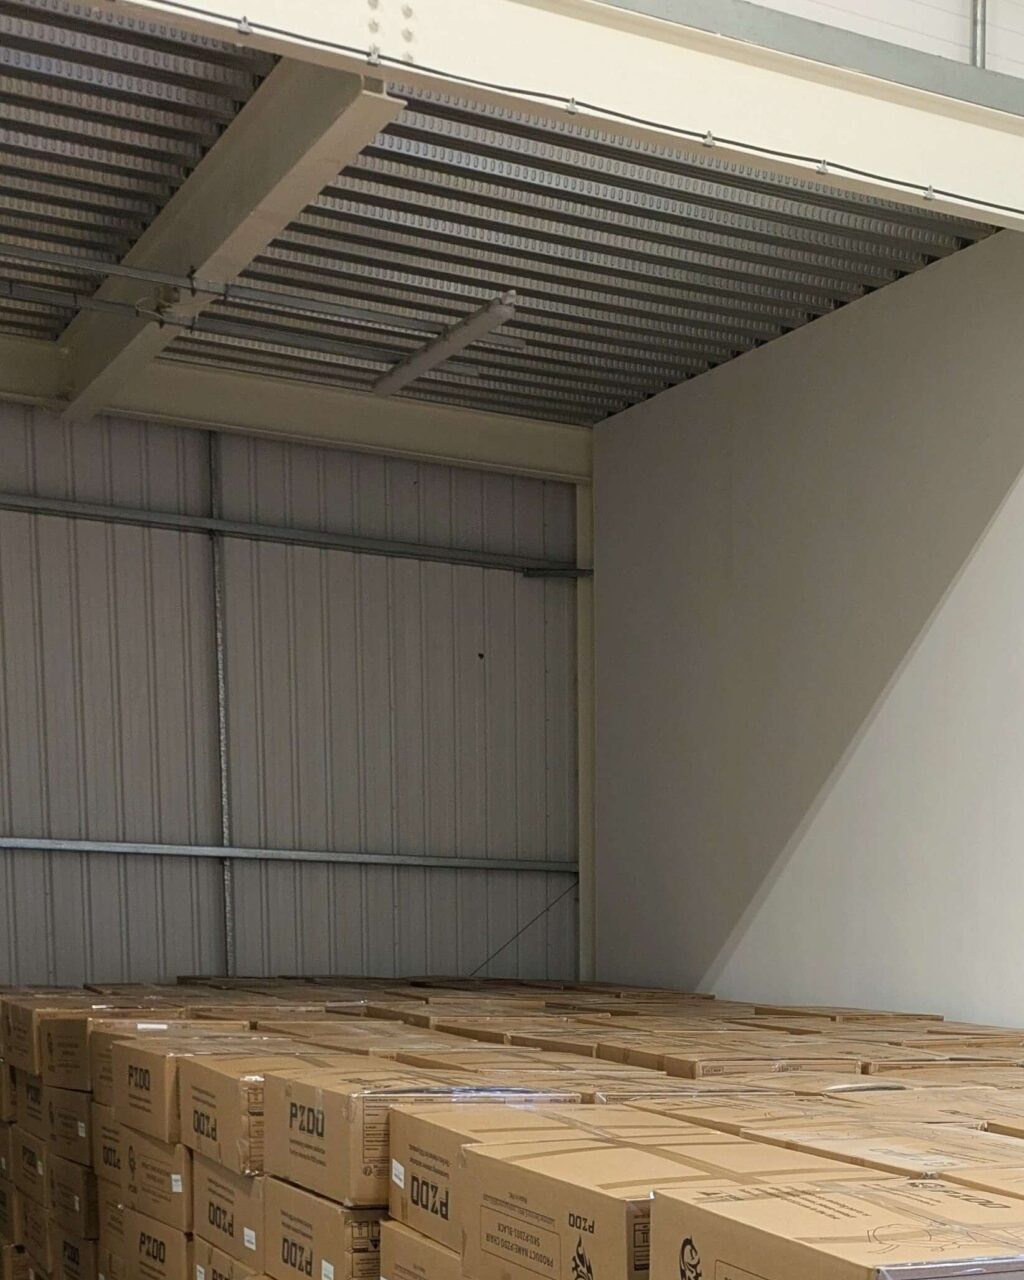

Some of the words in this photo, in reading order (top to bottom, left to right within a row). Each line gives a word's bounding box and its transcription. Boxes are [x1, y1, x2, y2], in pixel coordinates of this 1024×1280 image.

[128, 1065, 150, 1091] PZDO
[193, 1110, 217, 1141] PZDO
[289, 1102, 325, 1137] PZDO
[411, 1175, 449, 1221] PZDO
[208, 1202, 234, 1238] PZDO
[569, 1213, 594, 1233] PZDO
[139, 1232, 165, 1264] PZDO
[282, 1237, 313, 1277] PZDO
[530, 1250, 553, 1267] PRODUCT
